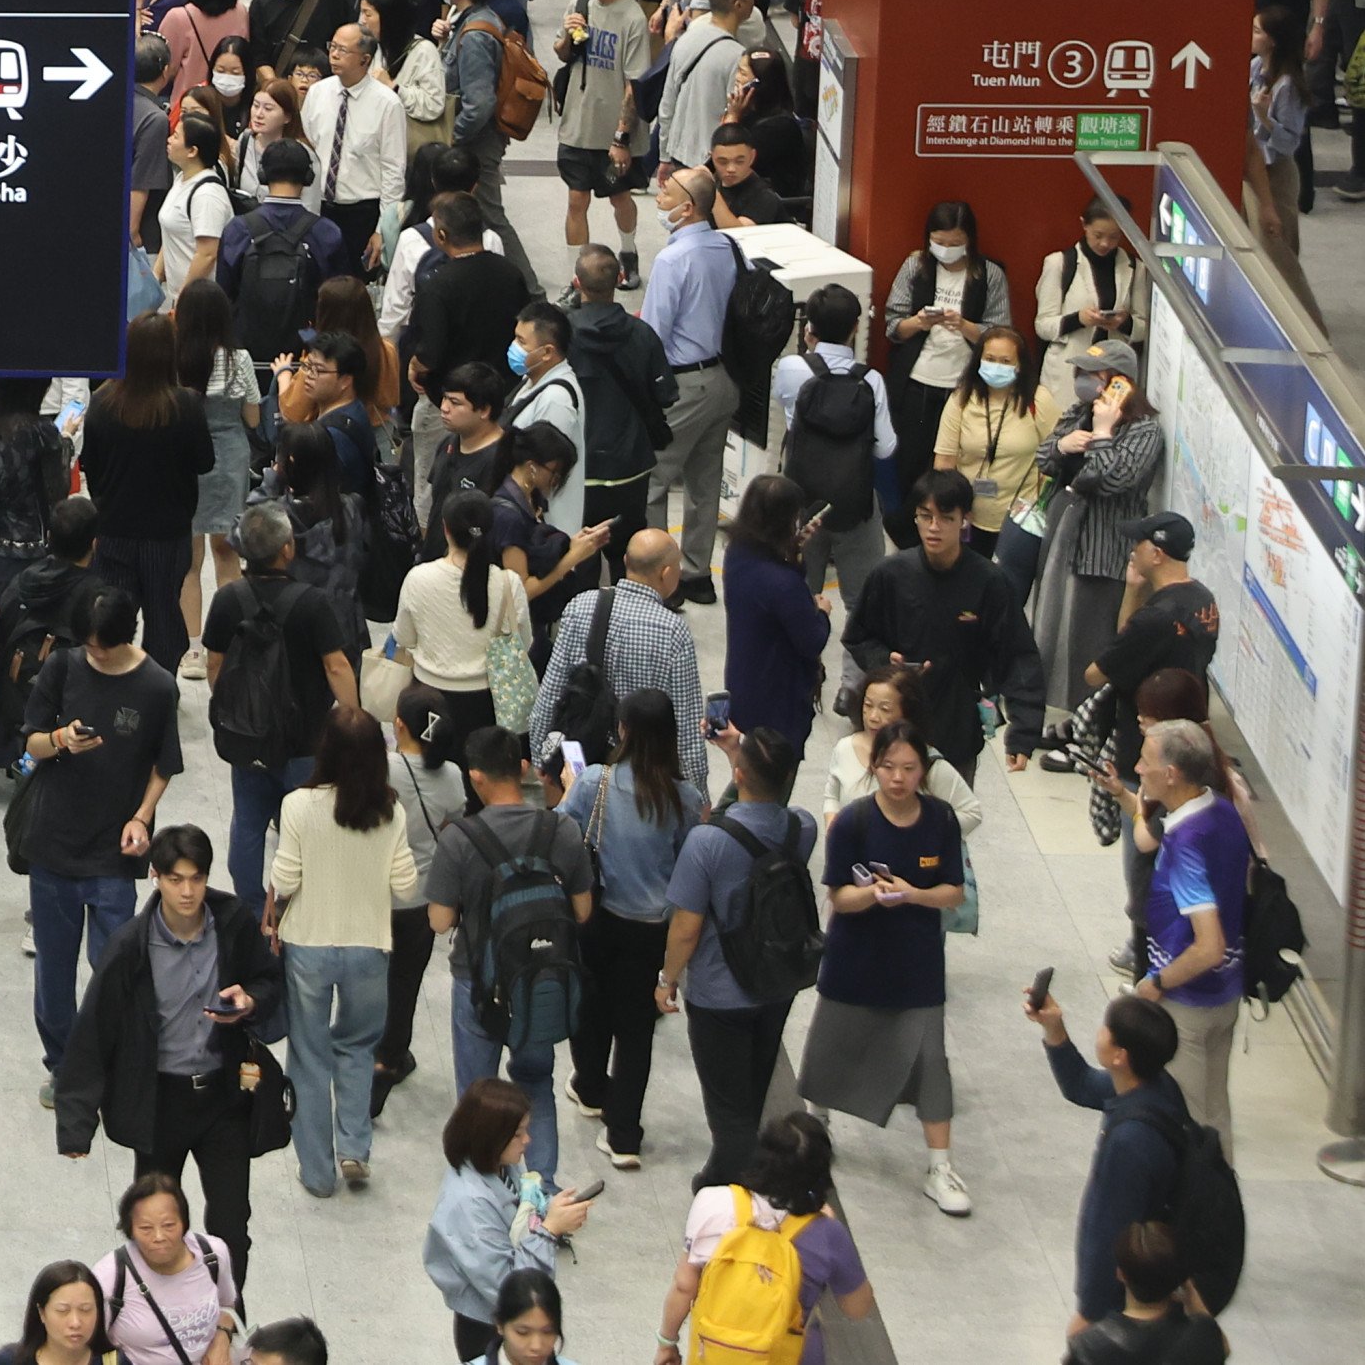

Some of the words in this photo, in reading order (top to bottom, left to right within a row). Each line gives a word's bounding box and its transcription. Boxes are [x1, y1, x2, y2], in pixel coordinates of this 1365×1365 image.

[983, 41, 1041, 69] 屯門
[1063, 51, 1082, 78] 3
[972, 74, 1006, 87] Tuen
[1009, 75, 1040, 87] Mun
[926, 115, 1074, 133] 經鑽石山站轉乘
[926, 136, 977, 147] Interchange
[989, 137, 1029, 145] Diamond
[1031, 137, 1045, 145] Hill
[1058, 137, 1073, 146] the
